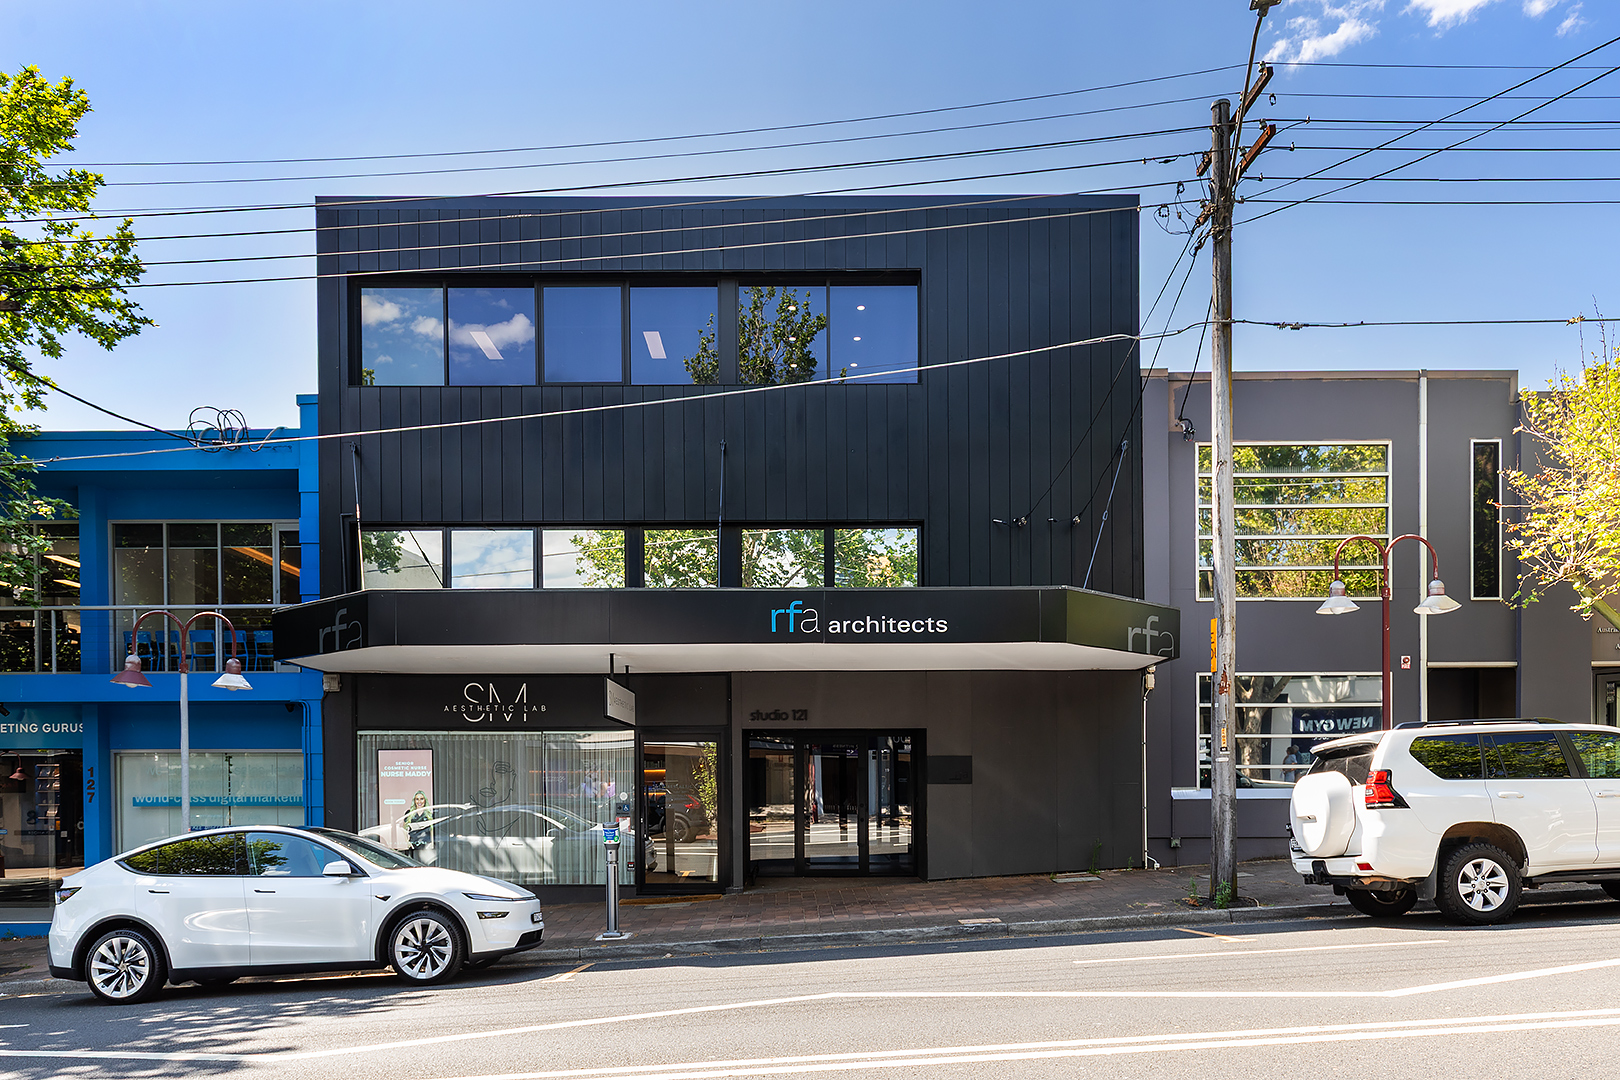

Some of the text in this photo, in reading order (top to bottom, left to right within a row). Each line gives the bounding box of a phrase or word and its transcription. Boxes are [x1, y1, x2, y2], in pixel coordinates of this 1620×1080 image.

[771, 600, 948, 633] rfa architects
[318, 607, 363, 654] rfa
[1127, 615, 1175, 658] rfa
[443, 704, 547, 712] AESTHETIC LAB
[749, 709, 808, 721] studio 121
[0, 723, 39, 733] ETING
[86, 766, 96, 804] 127
[209, 793, 245, 805] digital
